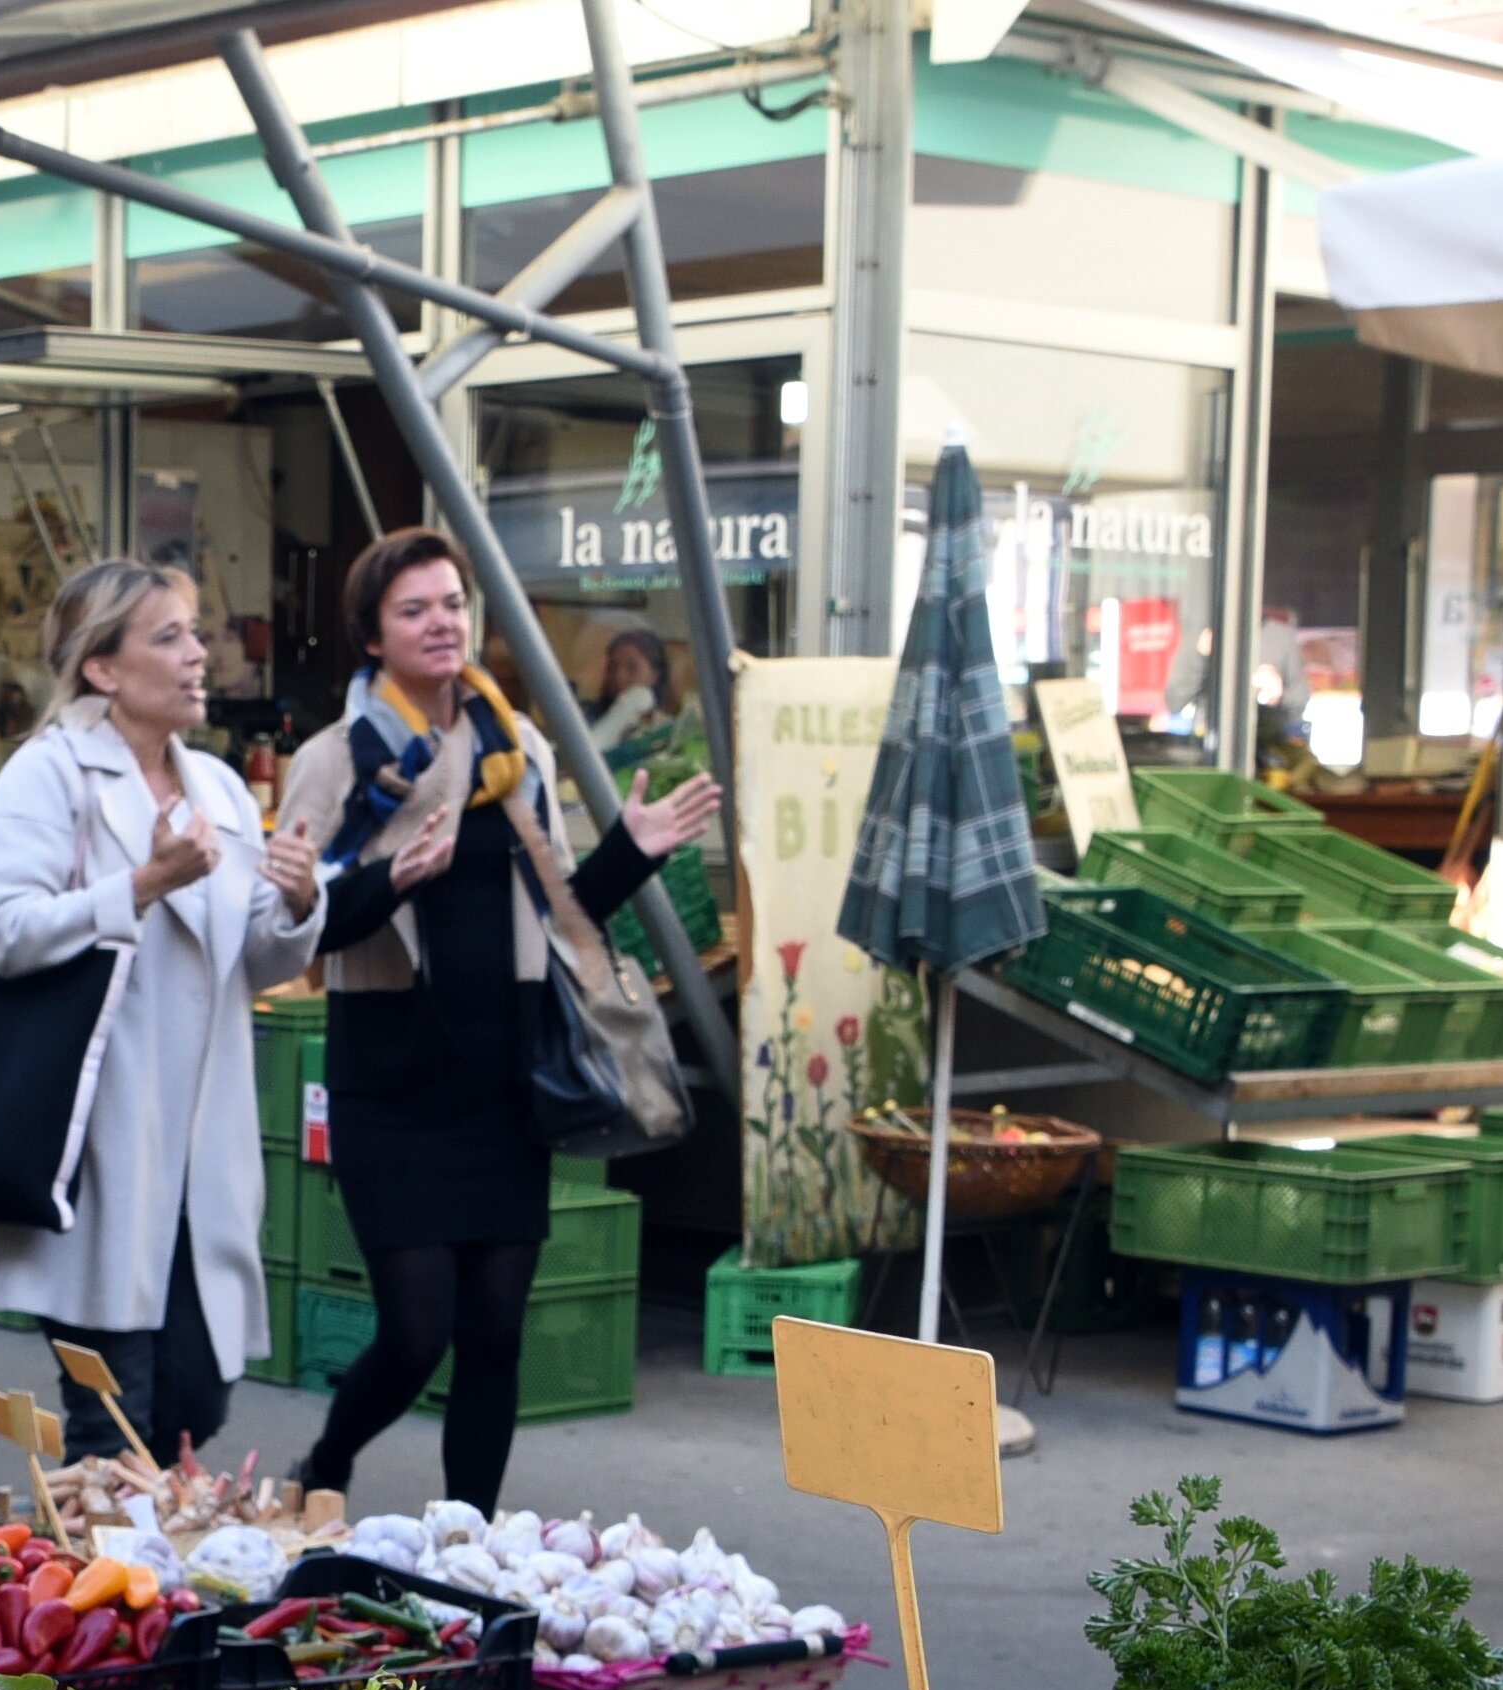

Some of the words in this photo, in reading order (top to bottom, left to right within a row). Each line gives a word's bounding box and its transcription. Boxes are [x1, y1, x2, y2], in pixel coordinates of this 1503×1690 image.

[559, 506, 603, 567] la
[621, 512, 793, 565] naura
[1070, 503, 1212, 558] natura
